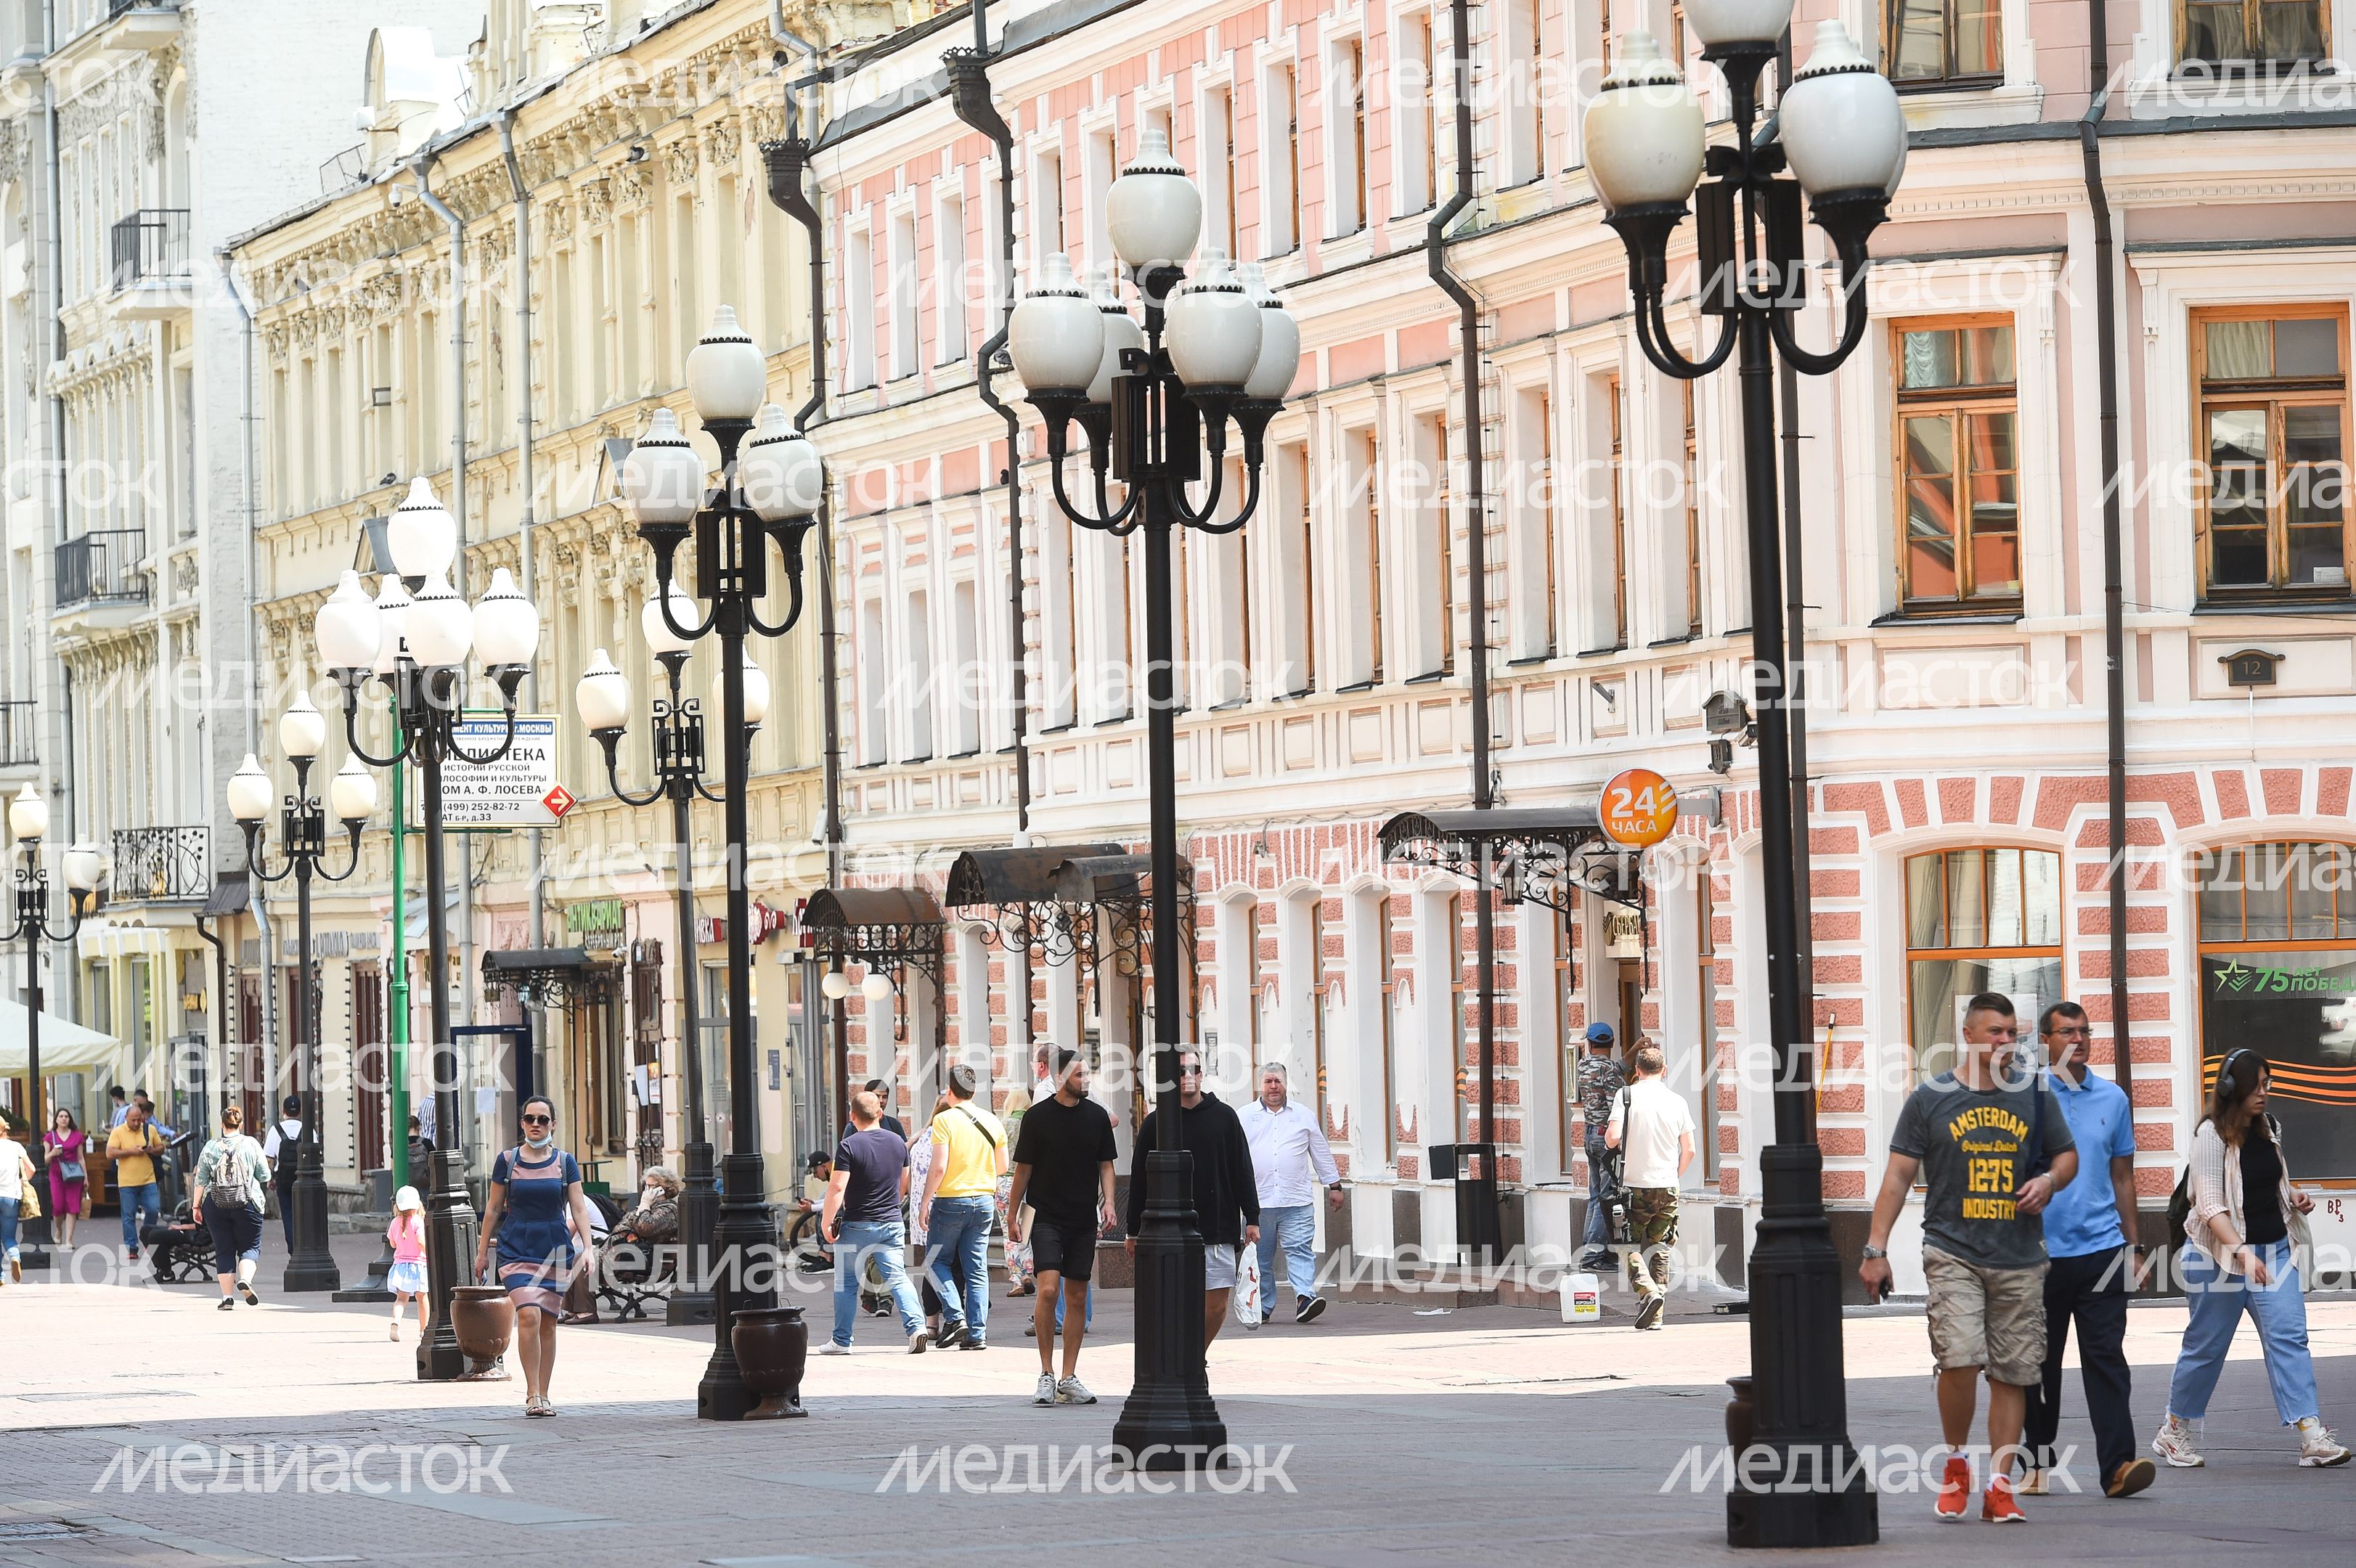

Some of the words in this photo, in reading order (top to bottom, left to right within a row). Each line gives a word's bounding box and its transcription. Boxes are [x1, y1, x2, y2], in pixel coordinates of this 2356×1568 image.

[2243, 661, 2261, 675] 12
[488, 763, 530, 772] РУССКОЙ
[463, 785, 474, 795] А.
[478, 785, 492, 795] Ф.
[443, 802, 469, 812] (499)
[471, 802, 520, 811] 252-82-72
[1610, 786, 1658, 819] 24
[1610, 819, 1658, 834] ЧАСА
[1612, 914, 1639, 936] СБЕРБА
[2254, 968, 2289, 992] 75
[1949, 1106, 2029, 1143] AMSTERDAM
[1968, 1158, 2013, 1193] 1275
[1962, 1198, 2017, 1220] INDUSTRY
[2339, 1214, 2344, 1222] 3
